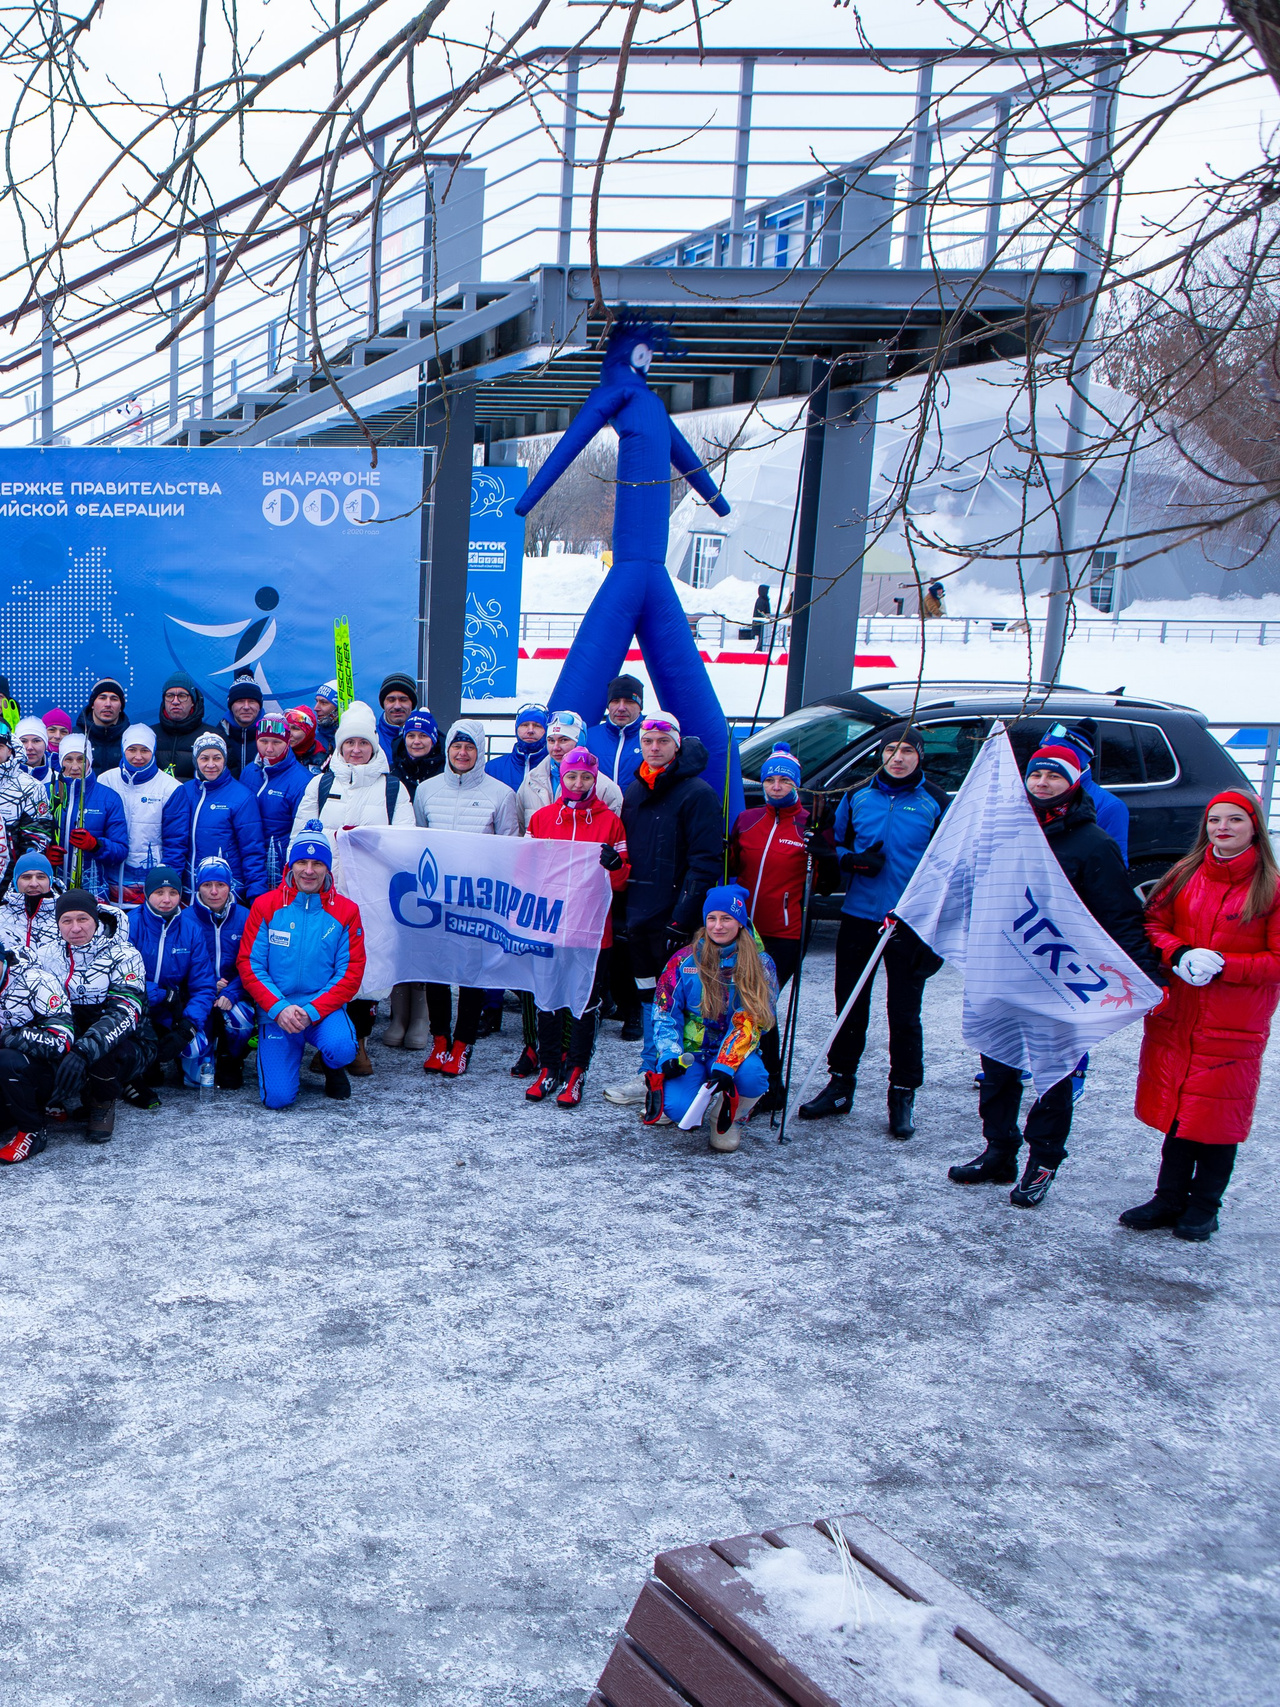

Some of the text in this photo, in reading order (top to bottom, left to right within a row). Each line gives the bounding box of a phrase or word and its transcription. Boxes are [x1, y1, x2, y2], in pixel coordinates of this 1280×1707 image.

[262, 471, 381, 487] ВМАРАФОНЕ
[70, 482, 222, 496] ПРАВИТЕЛЬСТВА
[75, 502, 185, 518] ФЕДЕРАЦИИ
[347, 527, 365, 535] 2020
[365, 528, 380, 536] года
[468, 541, 507, 551] ОСТОК
[336, 644, 346, 703] FISCHER
[342, 641, 354, 700] FISCHER
[444, 874, 564, 935] ГАЗПРОМ
[730, 904, 742, 917] SKI
[1013, 884, 1109, 1005] ТГК-2
[12, 1130, 39, 1162] alpin
